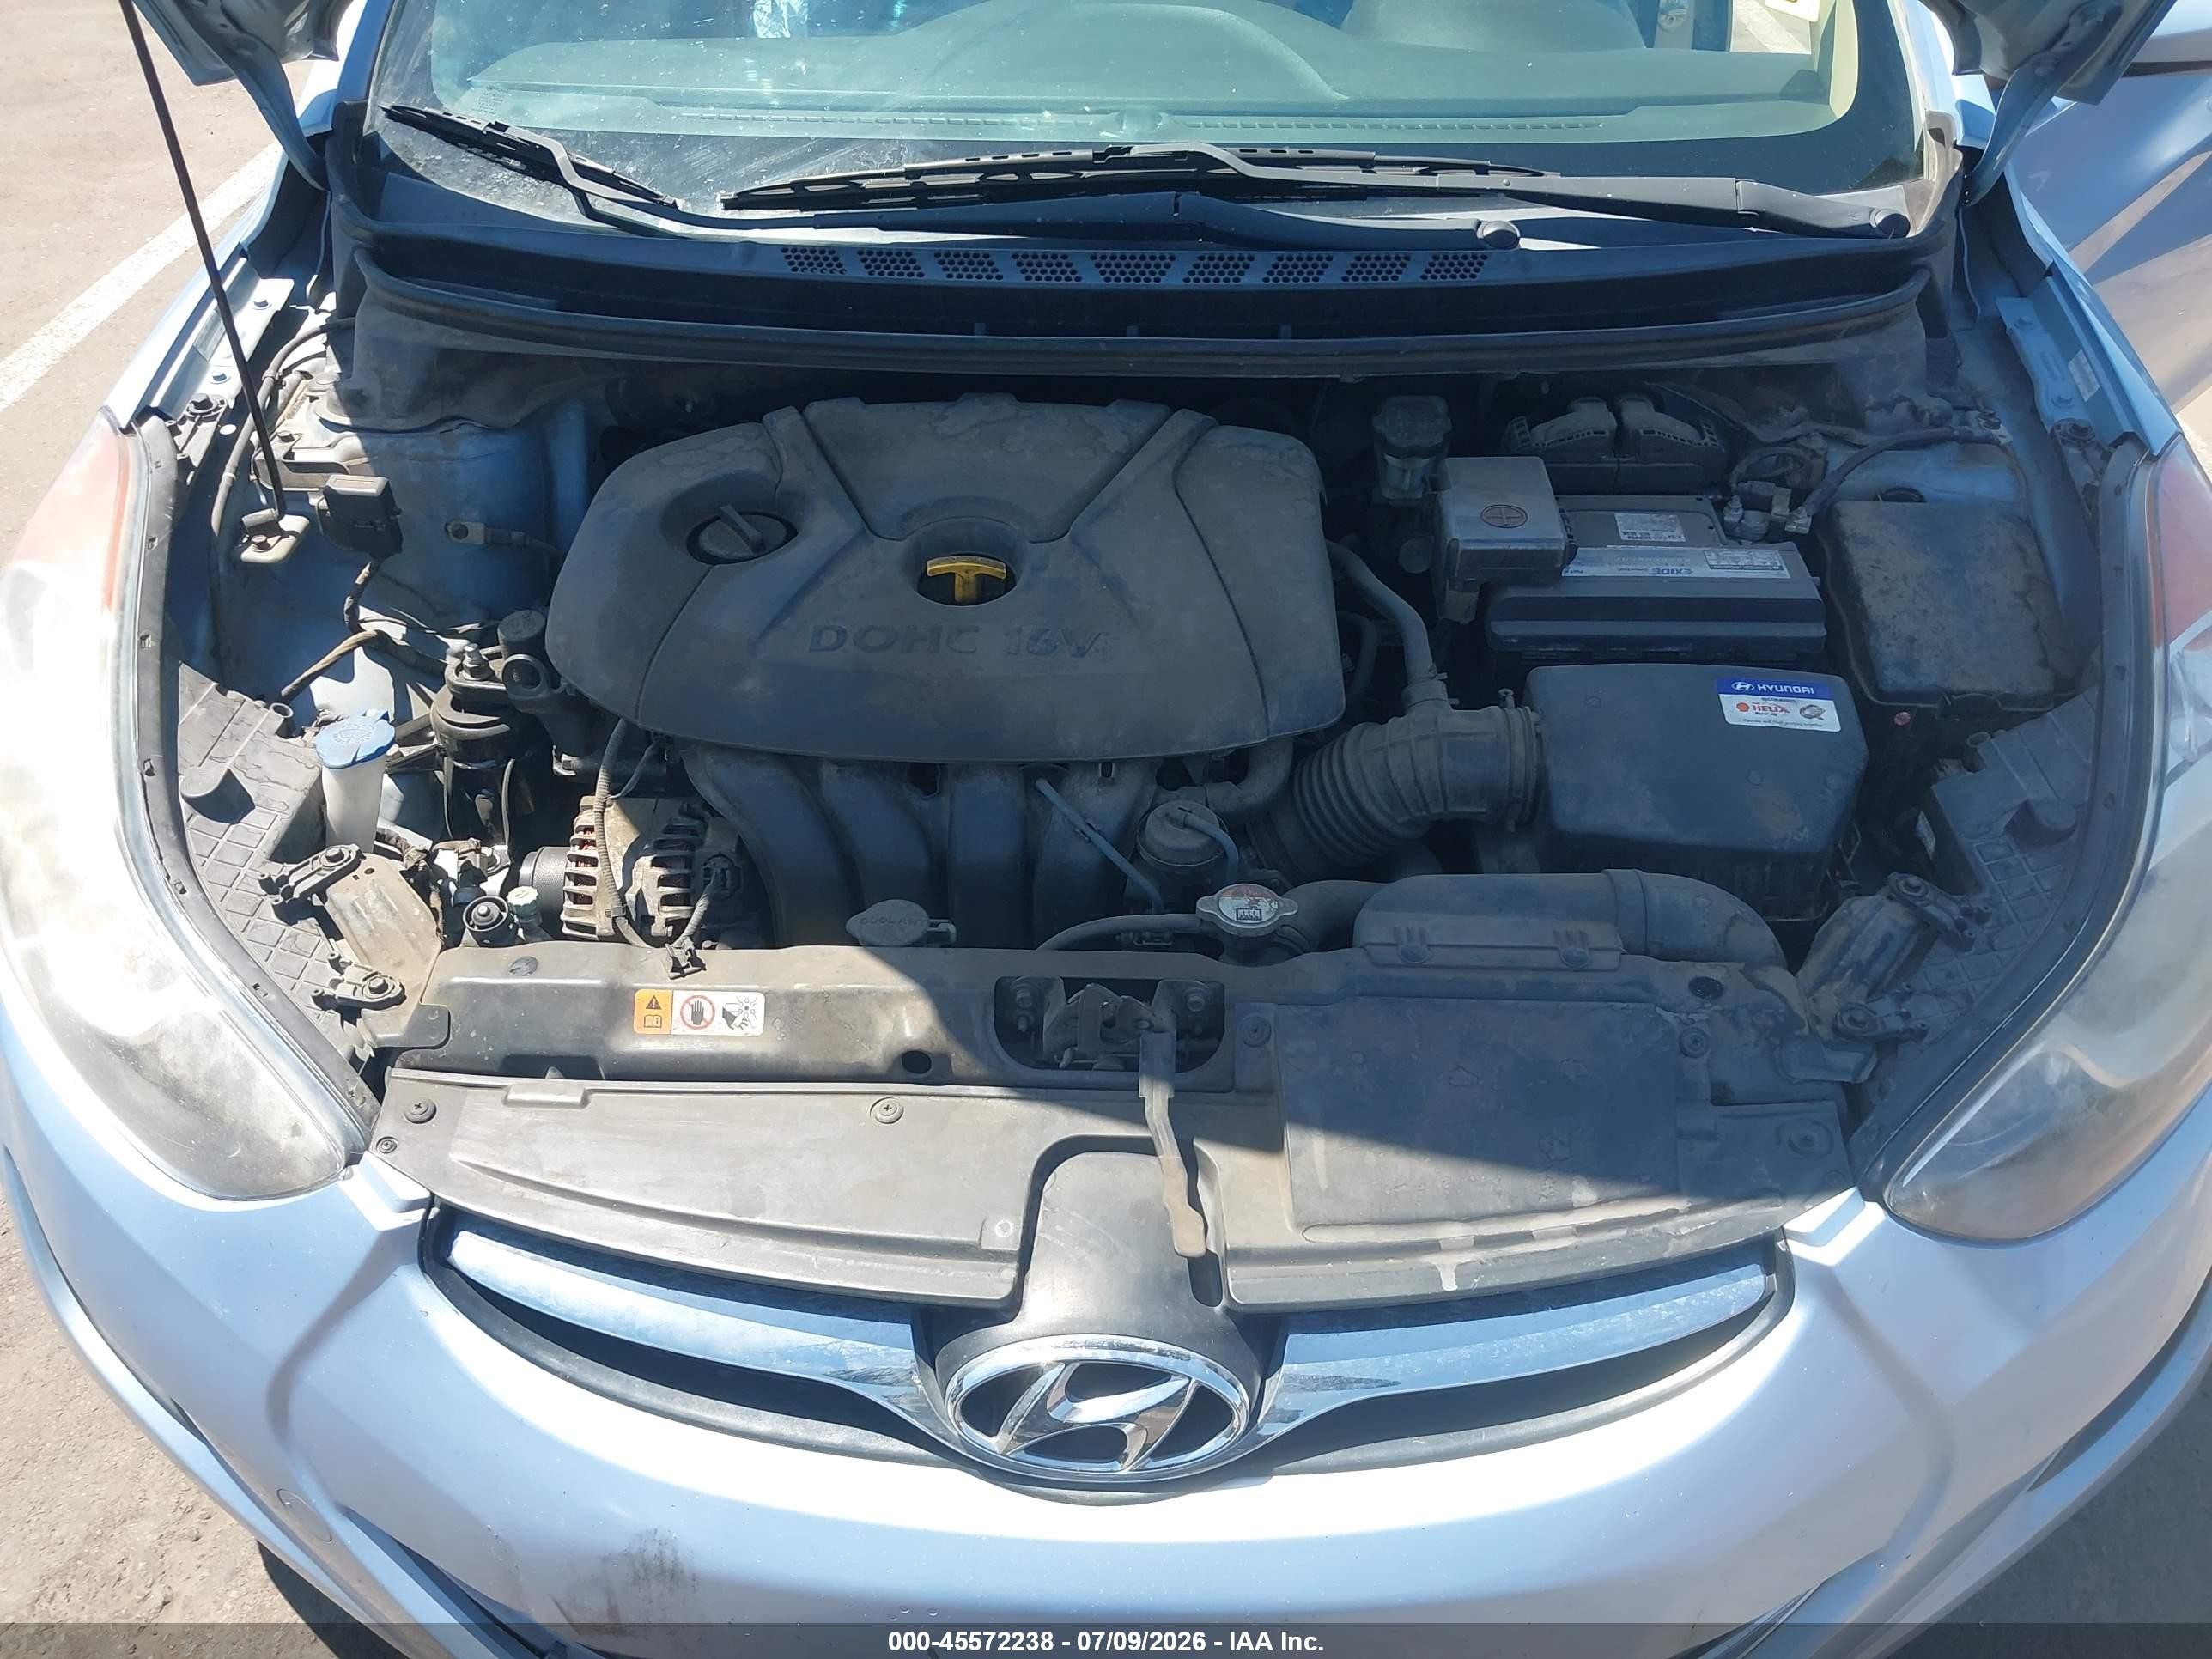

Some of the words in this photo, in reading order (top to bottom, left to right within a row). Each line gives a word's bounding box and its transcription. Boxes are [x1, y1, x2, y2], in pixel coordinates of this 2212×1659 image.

[1651, 567, 1693, 575] EXIDE
[809, 624, 982, 653] DOHC
[1757, 684, 1814, 695] HYUNDAI
[1753, 704, 1790, 714] HELIX
[860, 915, 927, 927] COOLANT
